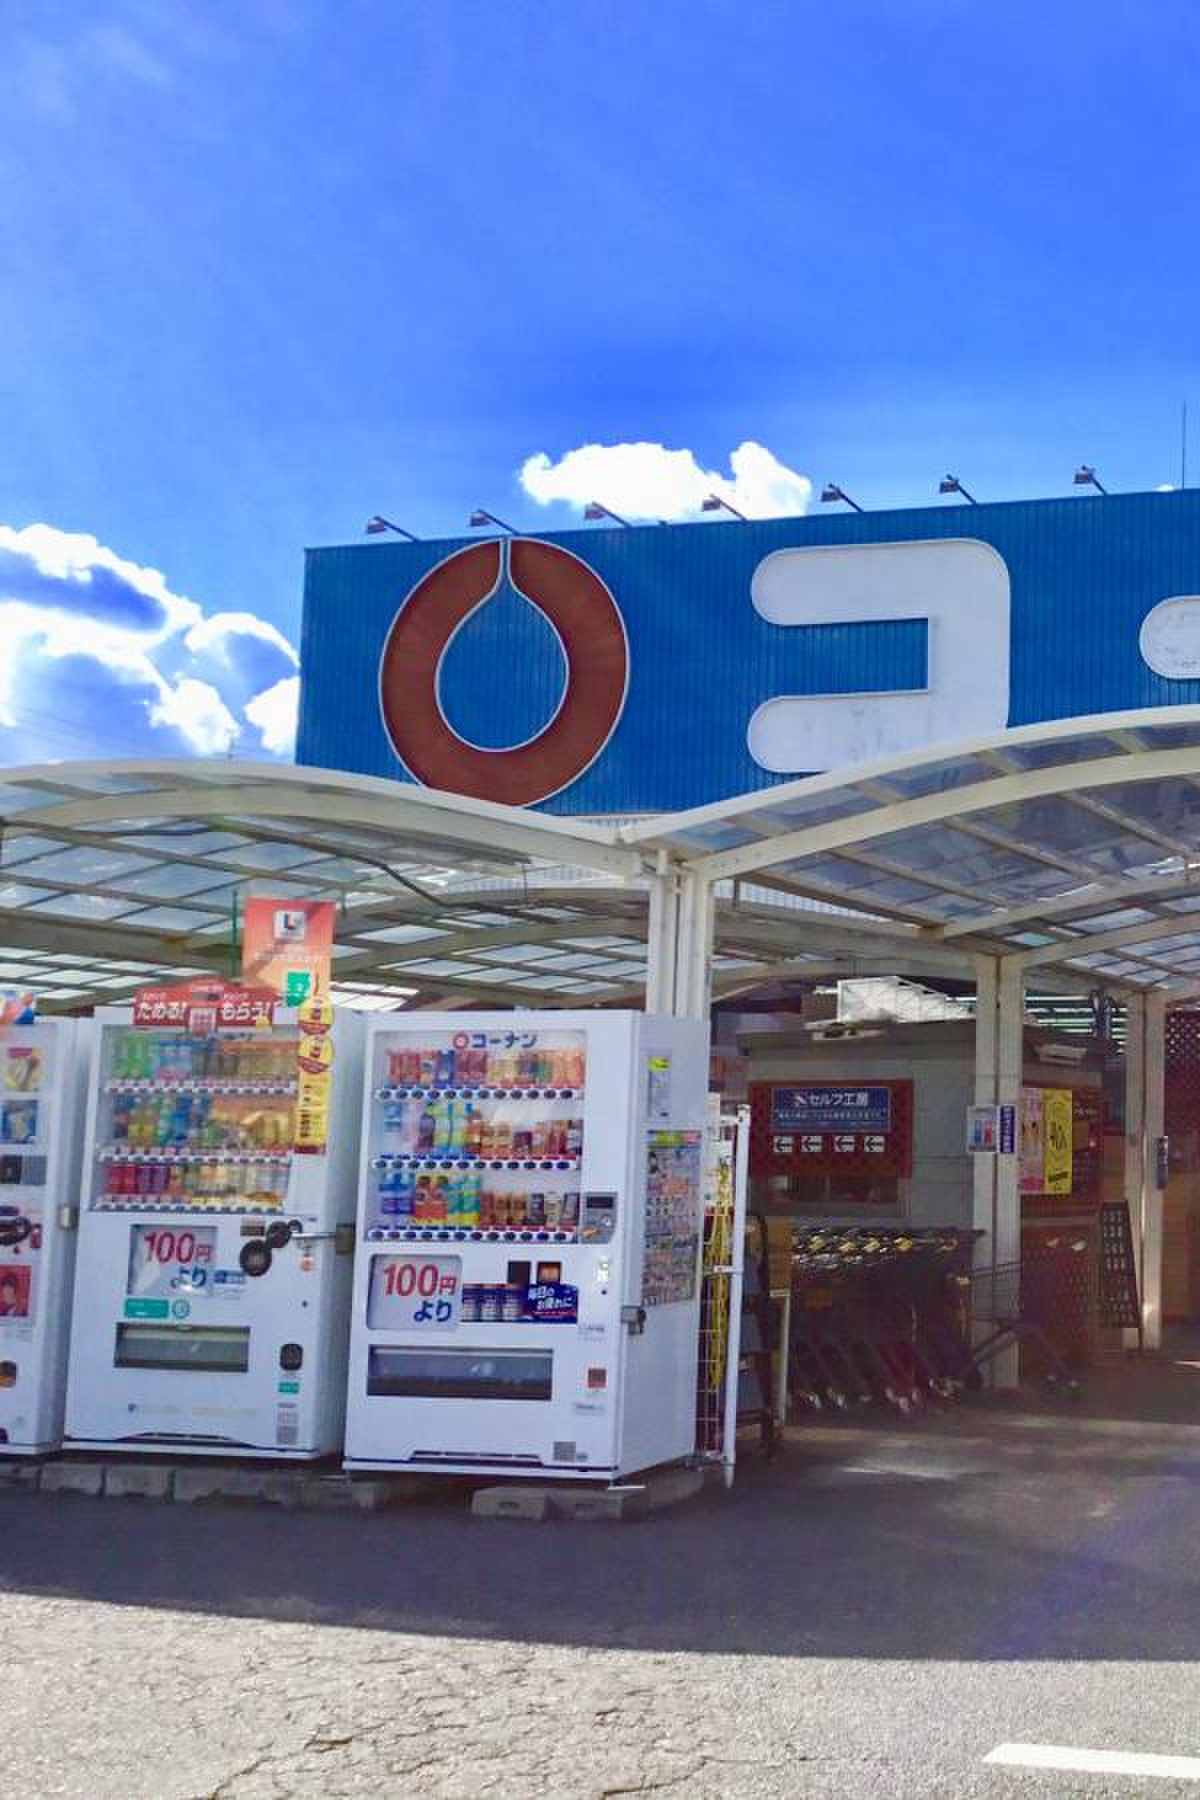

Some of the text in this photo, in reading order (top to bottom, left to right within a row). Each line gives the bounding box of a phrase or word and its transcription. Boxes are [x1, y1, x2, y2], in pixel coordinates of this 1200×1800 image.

[471, 1033, 538, 1048] コーナン
[144, 1231, 216, 1264] 100円
[383, 1263, 457, 1297] 100円
[413, 1300, 453, 1323] より
